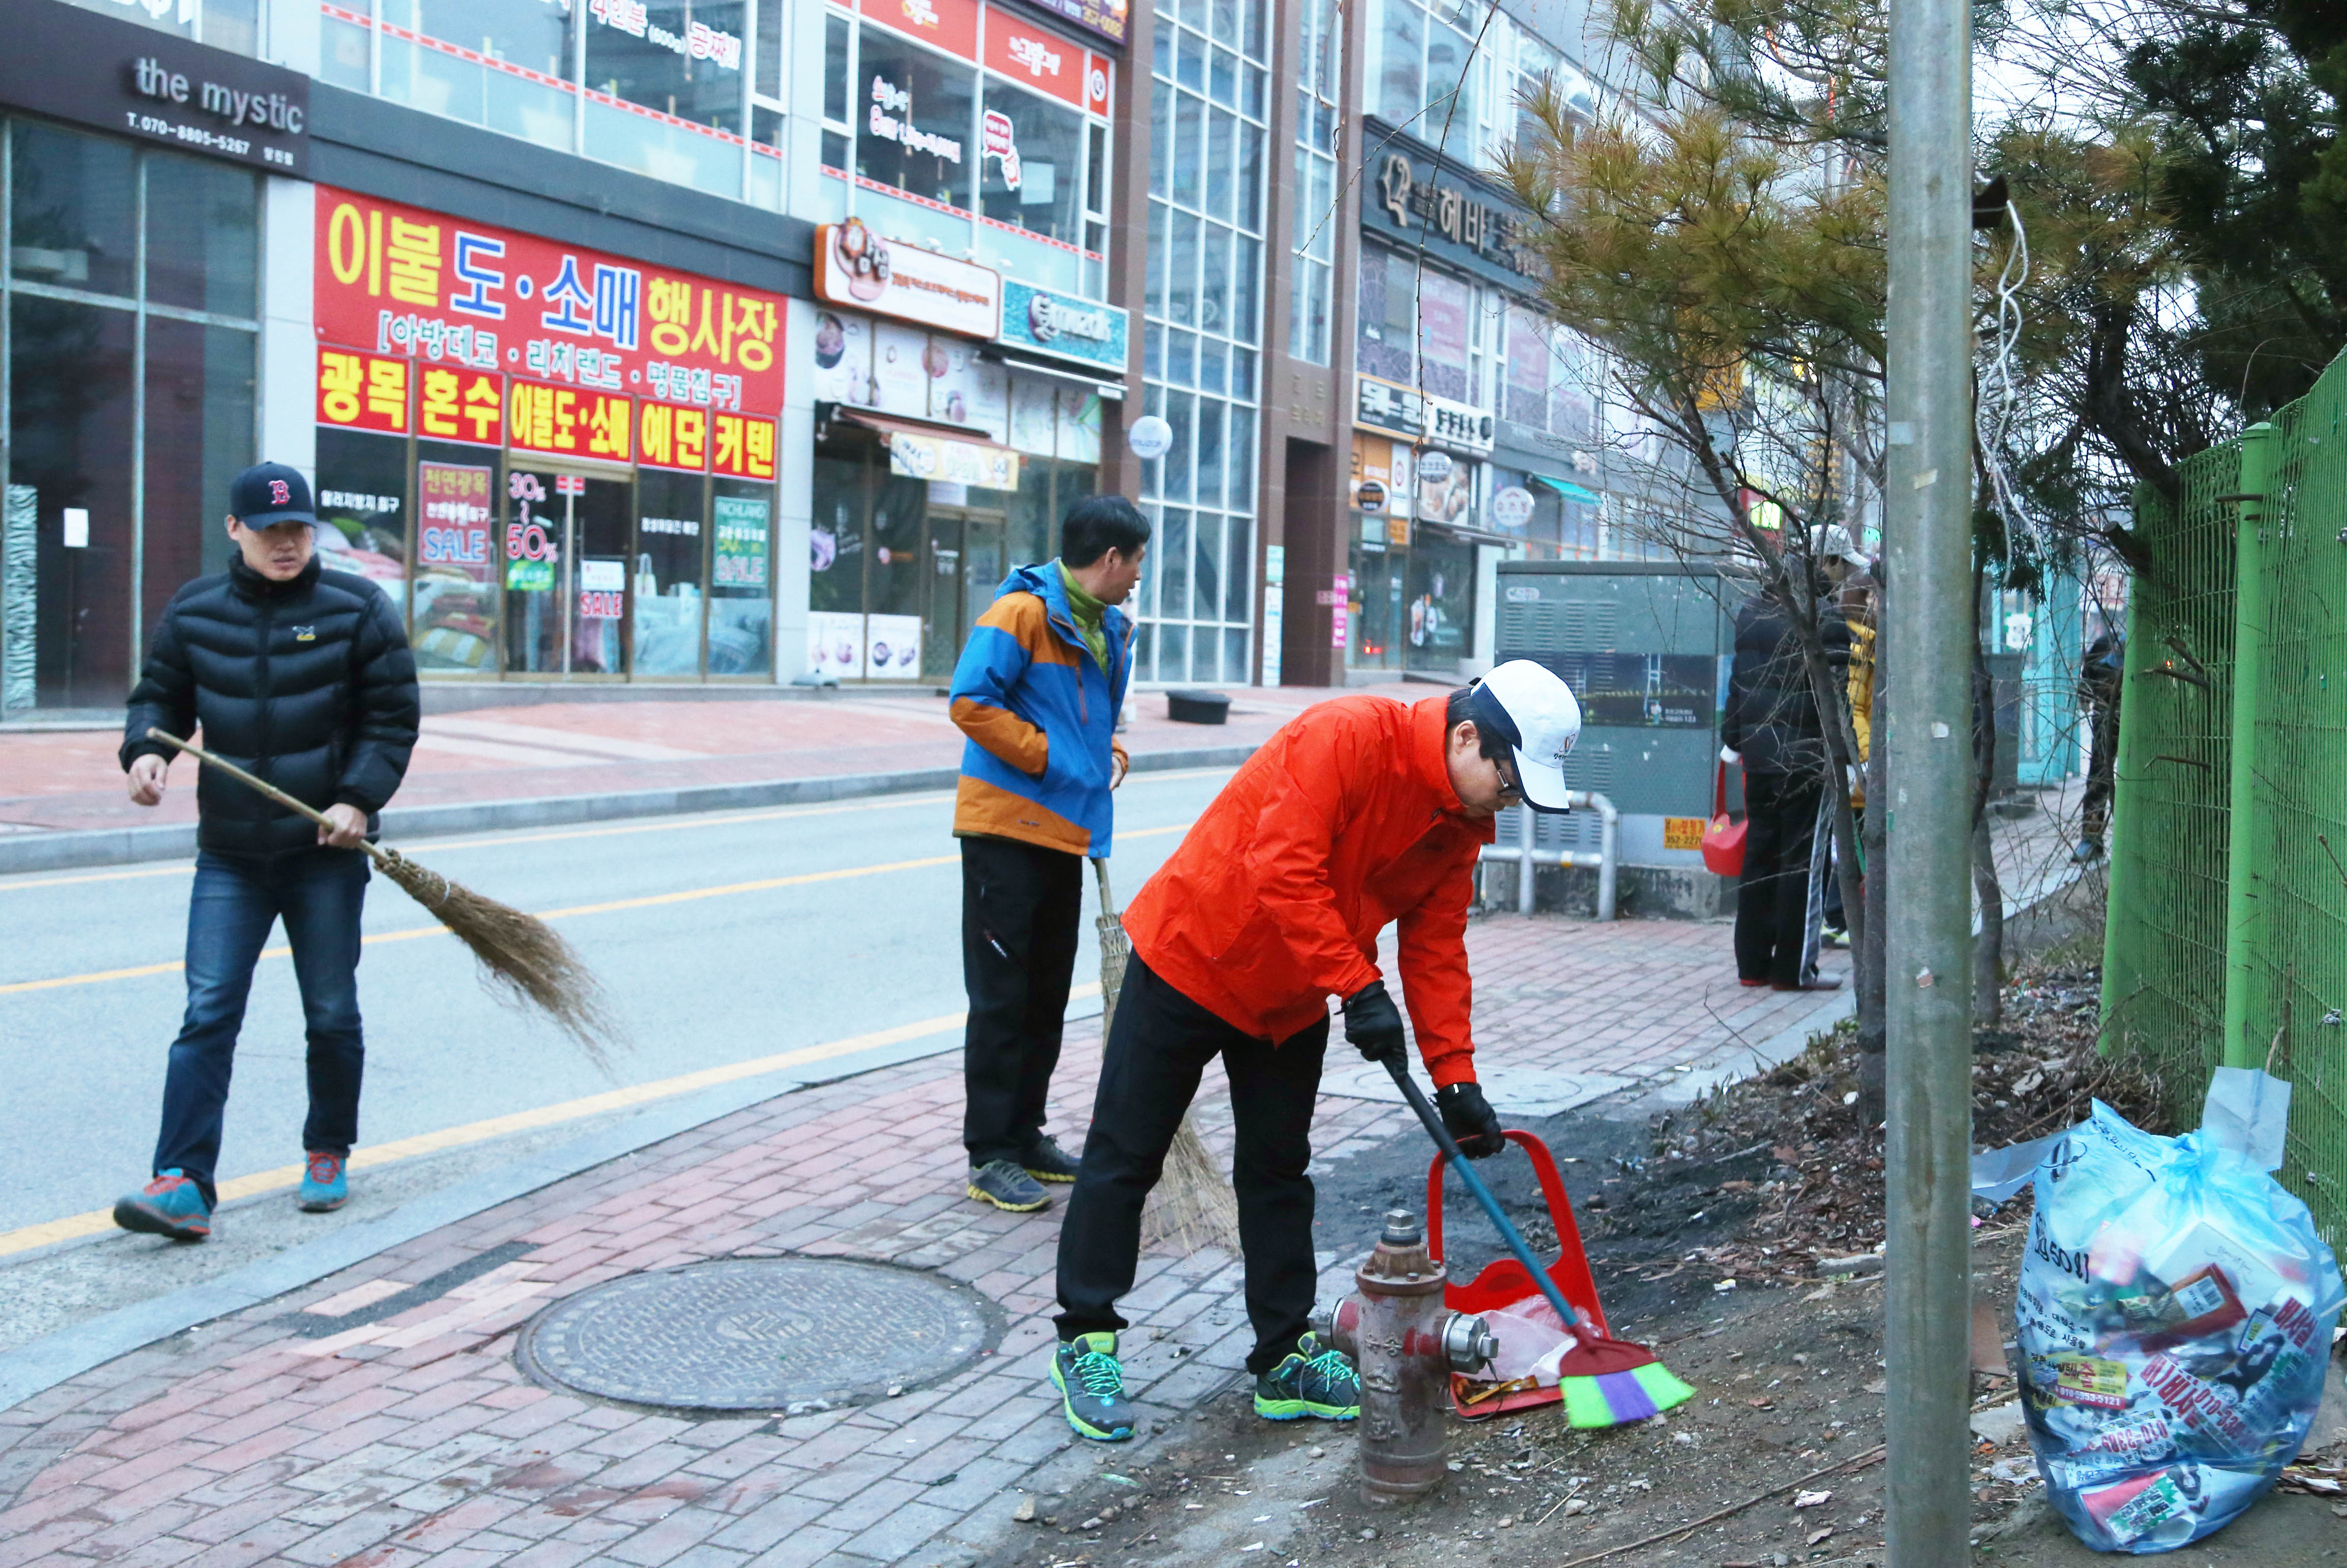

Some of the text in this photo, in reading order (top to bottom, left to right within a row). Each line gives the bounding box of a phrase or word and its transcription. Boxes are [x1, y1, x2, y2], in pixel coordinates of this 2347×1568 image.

[134, 56, 304, 134] the mystic
[328, 203, 442, 307] 이불
[648, 277, 778, 372] 행사장
[321, 352, 405, 430] 광목
[423, 370, 501, 440] 혼수
[641, 404, 706, 467] 예단
[714, 415, 773, 476] 커텐
[268, 479, 291, 504] B
[509, 472, 547, 502] 30%
[423, 527, 487, 562] SALE
[506, 523, 559, 563] 50%
[715, 554, 766, 584] SALE
[580, 591, 623, 619] SALE
